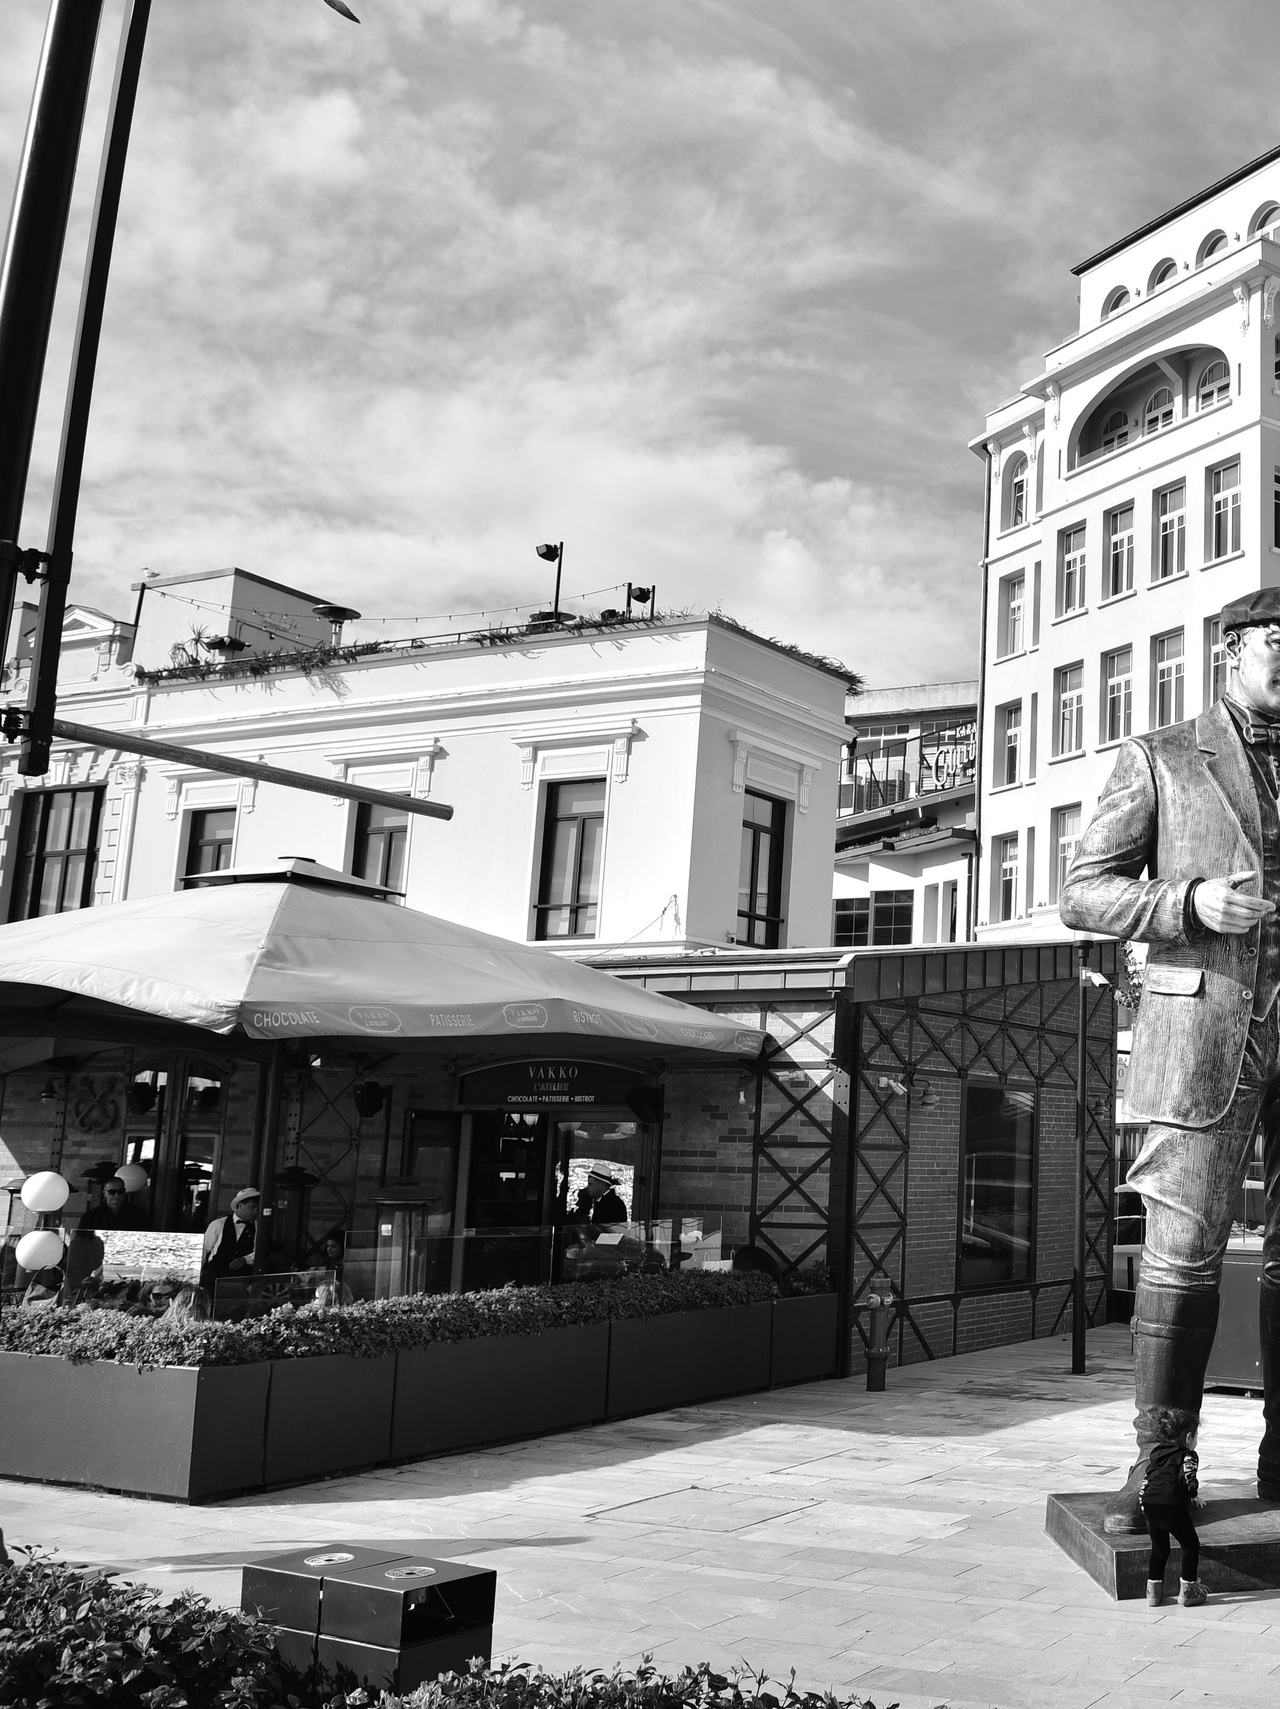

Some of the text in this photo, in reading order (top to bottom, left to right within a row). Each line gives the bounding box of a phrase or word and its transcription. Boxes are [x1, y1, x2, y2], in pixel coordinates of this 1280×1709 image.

[253, 1011, 321, 1028] CHOCOLATE
[429, 1013, 475, 1027] PATISSERIE
[572, 1010, 603, 1025] BISTROT
[529, 1066, 578, 1079] VAKKO
[534, 1082, 570, 1091] L'ATELIER
[507, 1095, 595, 1103] CHOCOLATE PATISSERIE BISTROT
